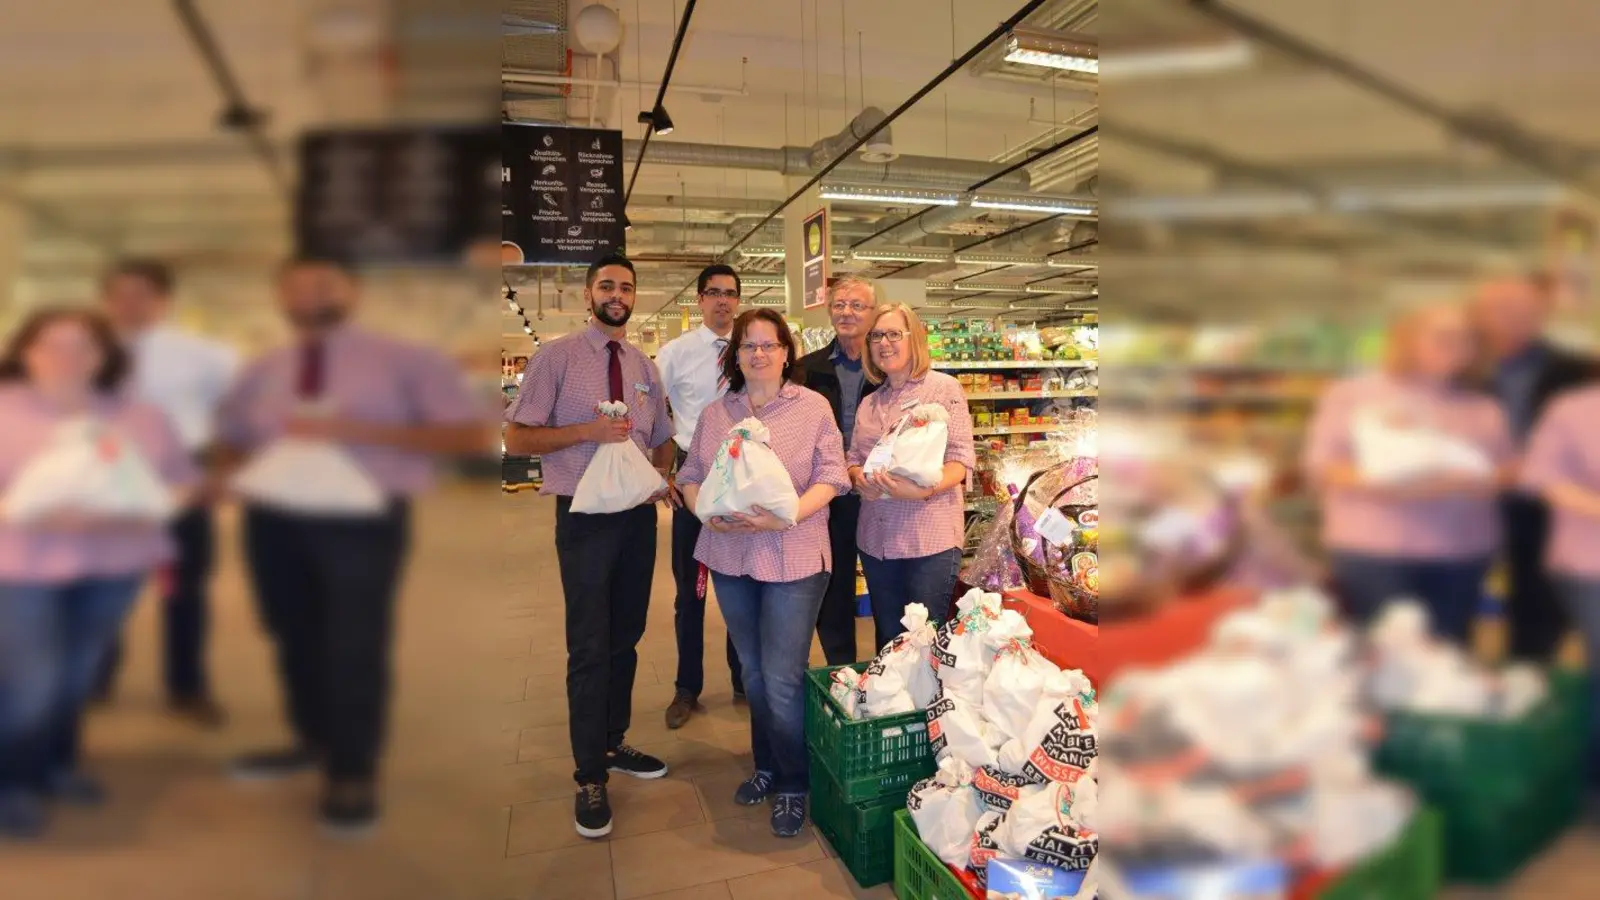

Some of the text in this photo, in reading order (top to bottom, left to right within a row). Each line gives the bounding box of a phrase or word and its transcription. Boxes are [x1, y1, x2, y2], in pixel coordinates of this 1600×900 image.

[533, 149, 562, 157] Qualitäts-
[530, 155, 566, 163] Versprechen
[557, 244, 594, 252] Versprechen
[1032, 836, 1065, 854] MAL
[1026, 852, 1091, 871] JEMAND
